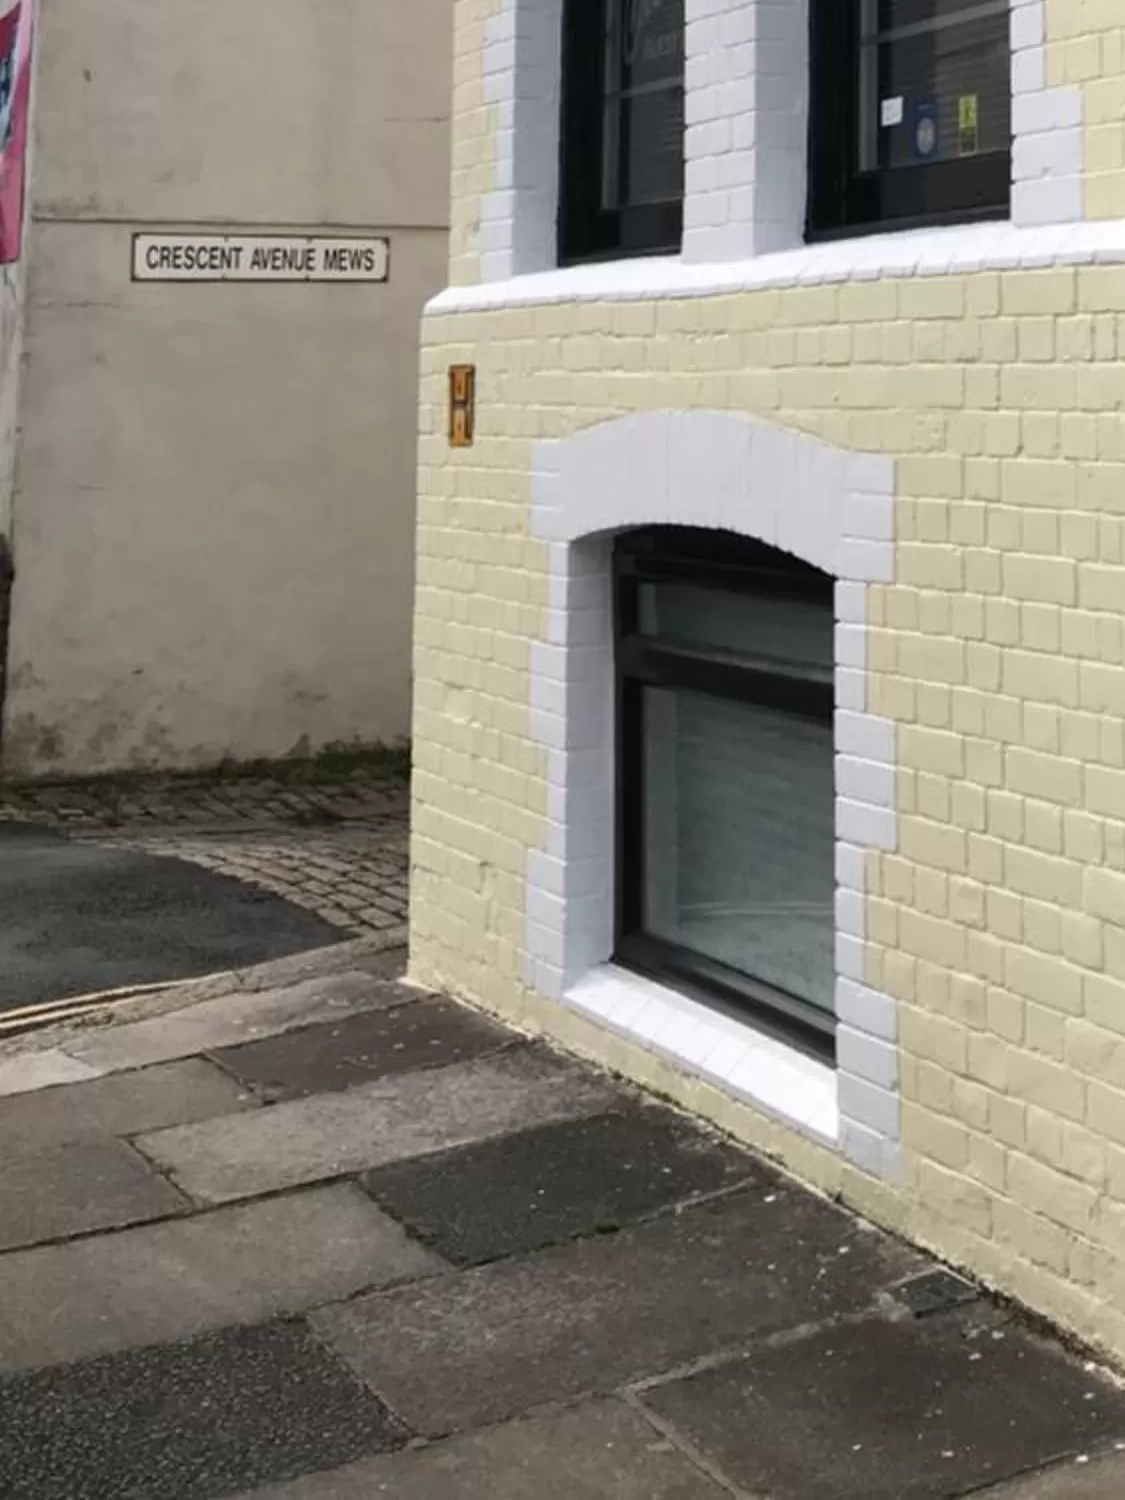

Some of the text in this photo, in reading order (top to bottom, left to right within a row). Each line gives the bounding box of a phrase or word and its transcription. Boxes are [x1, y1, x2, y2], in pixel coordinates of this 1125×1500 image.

[145, 244, 375, 272] CRESCENT AVENUE MEWS
